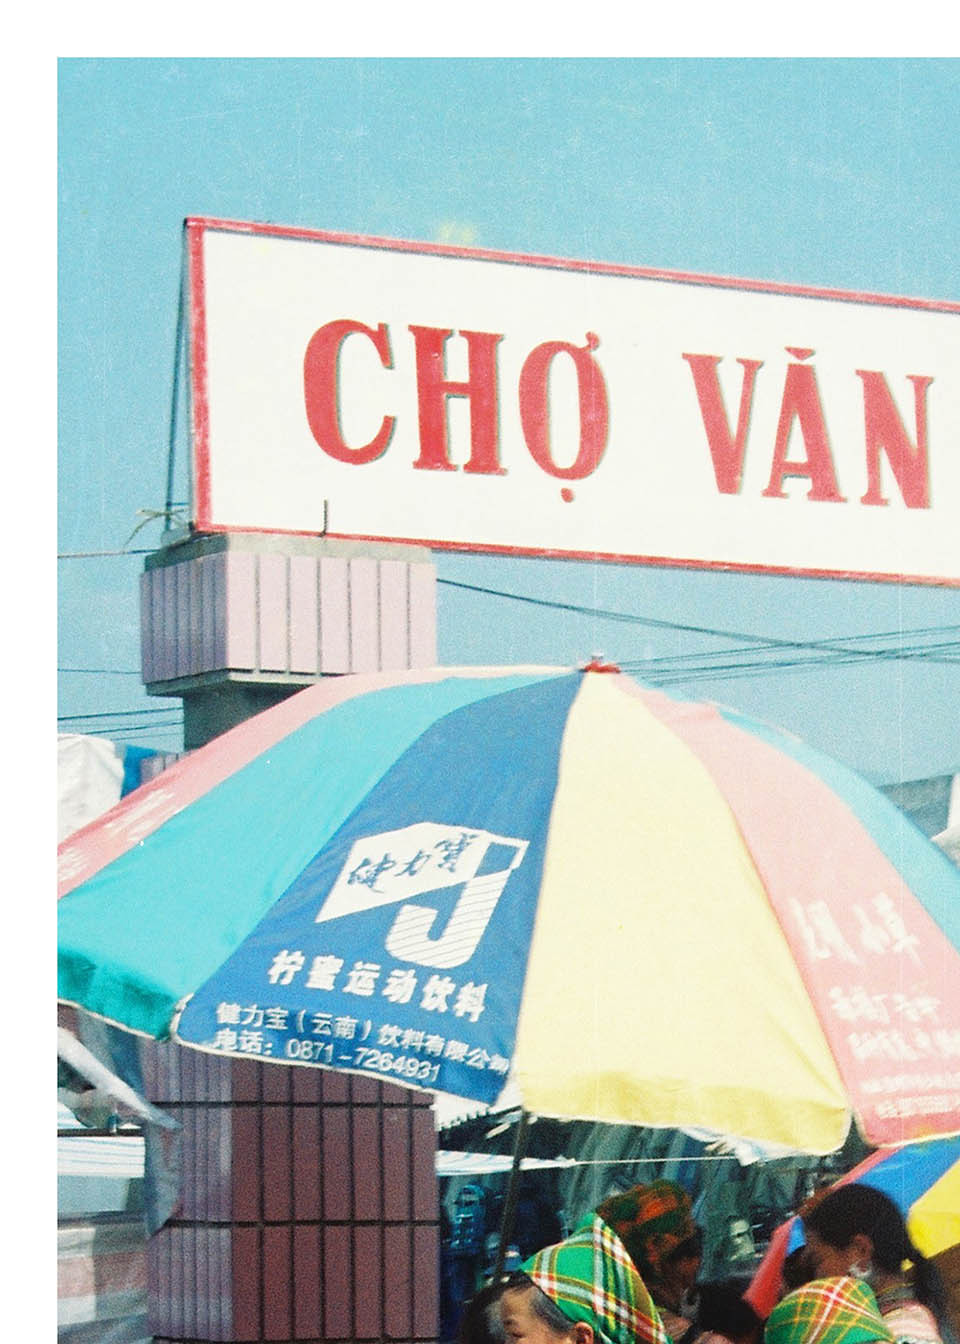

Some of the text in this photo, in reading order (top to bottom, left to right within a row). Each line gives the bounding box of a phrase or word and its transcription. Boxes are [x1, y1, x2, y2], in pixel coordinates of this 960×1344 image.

[303, 318, 610, 503] CHỢ
[682, 346, 935, 510] VĂN
[267, 949, 489, 1023] 柠蜜运动饮料
